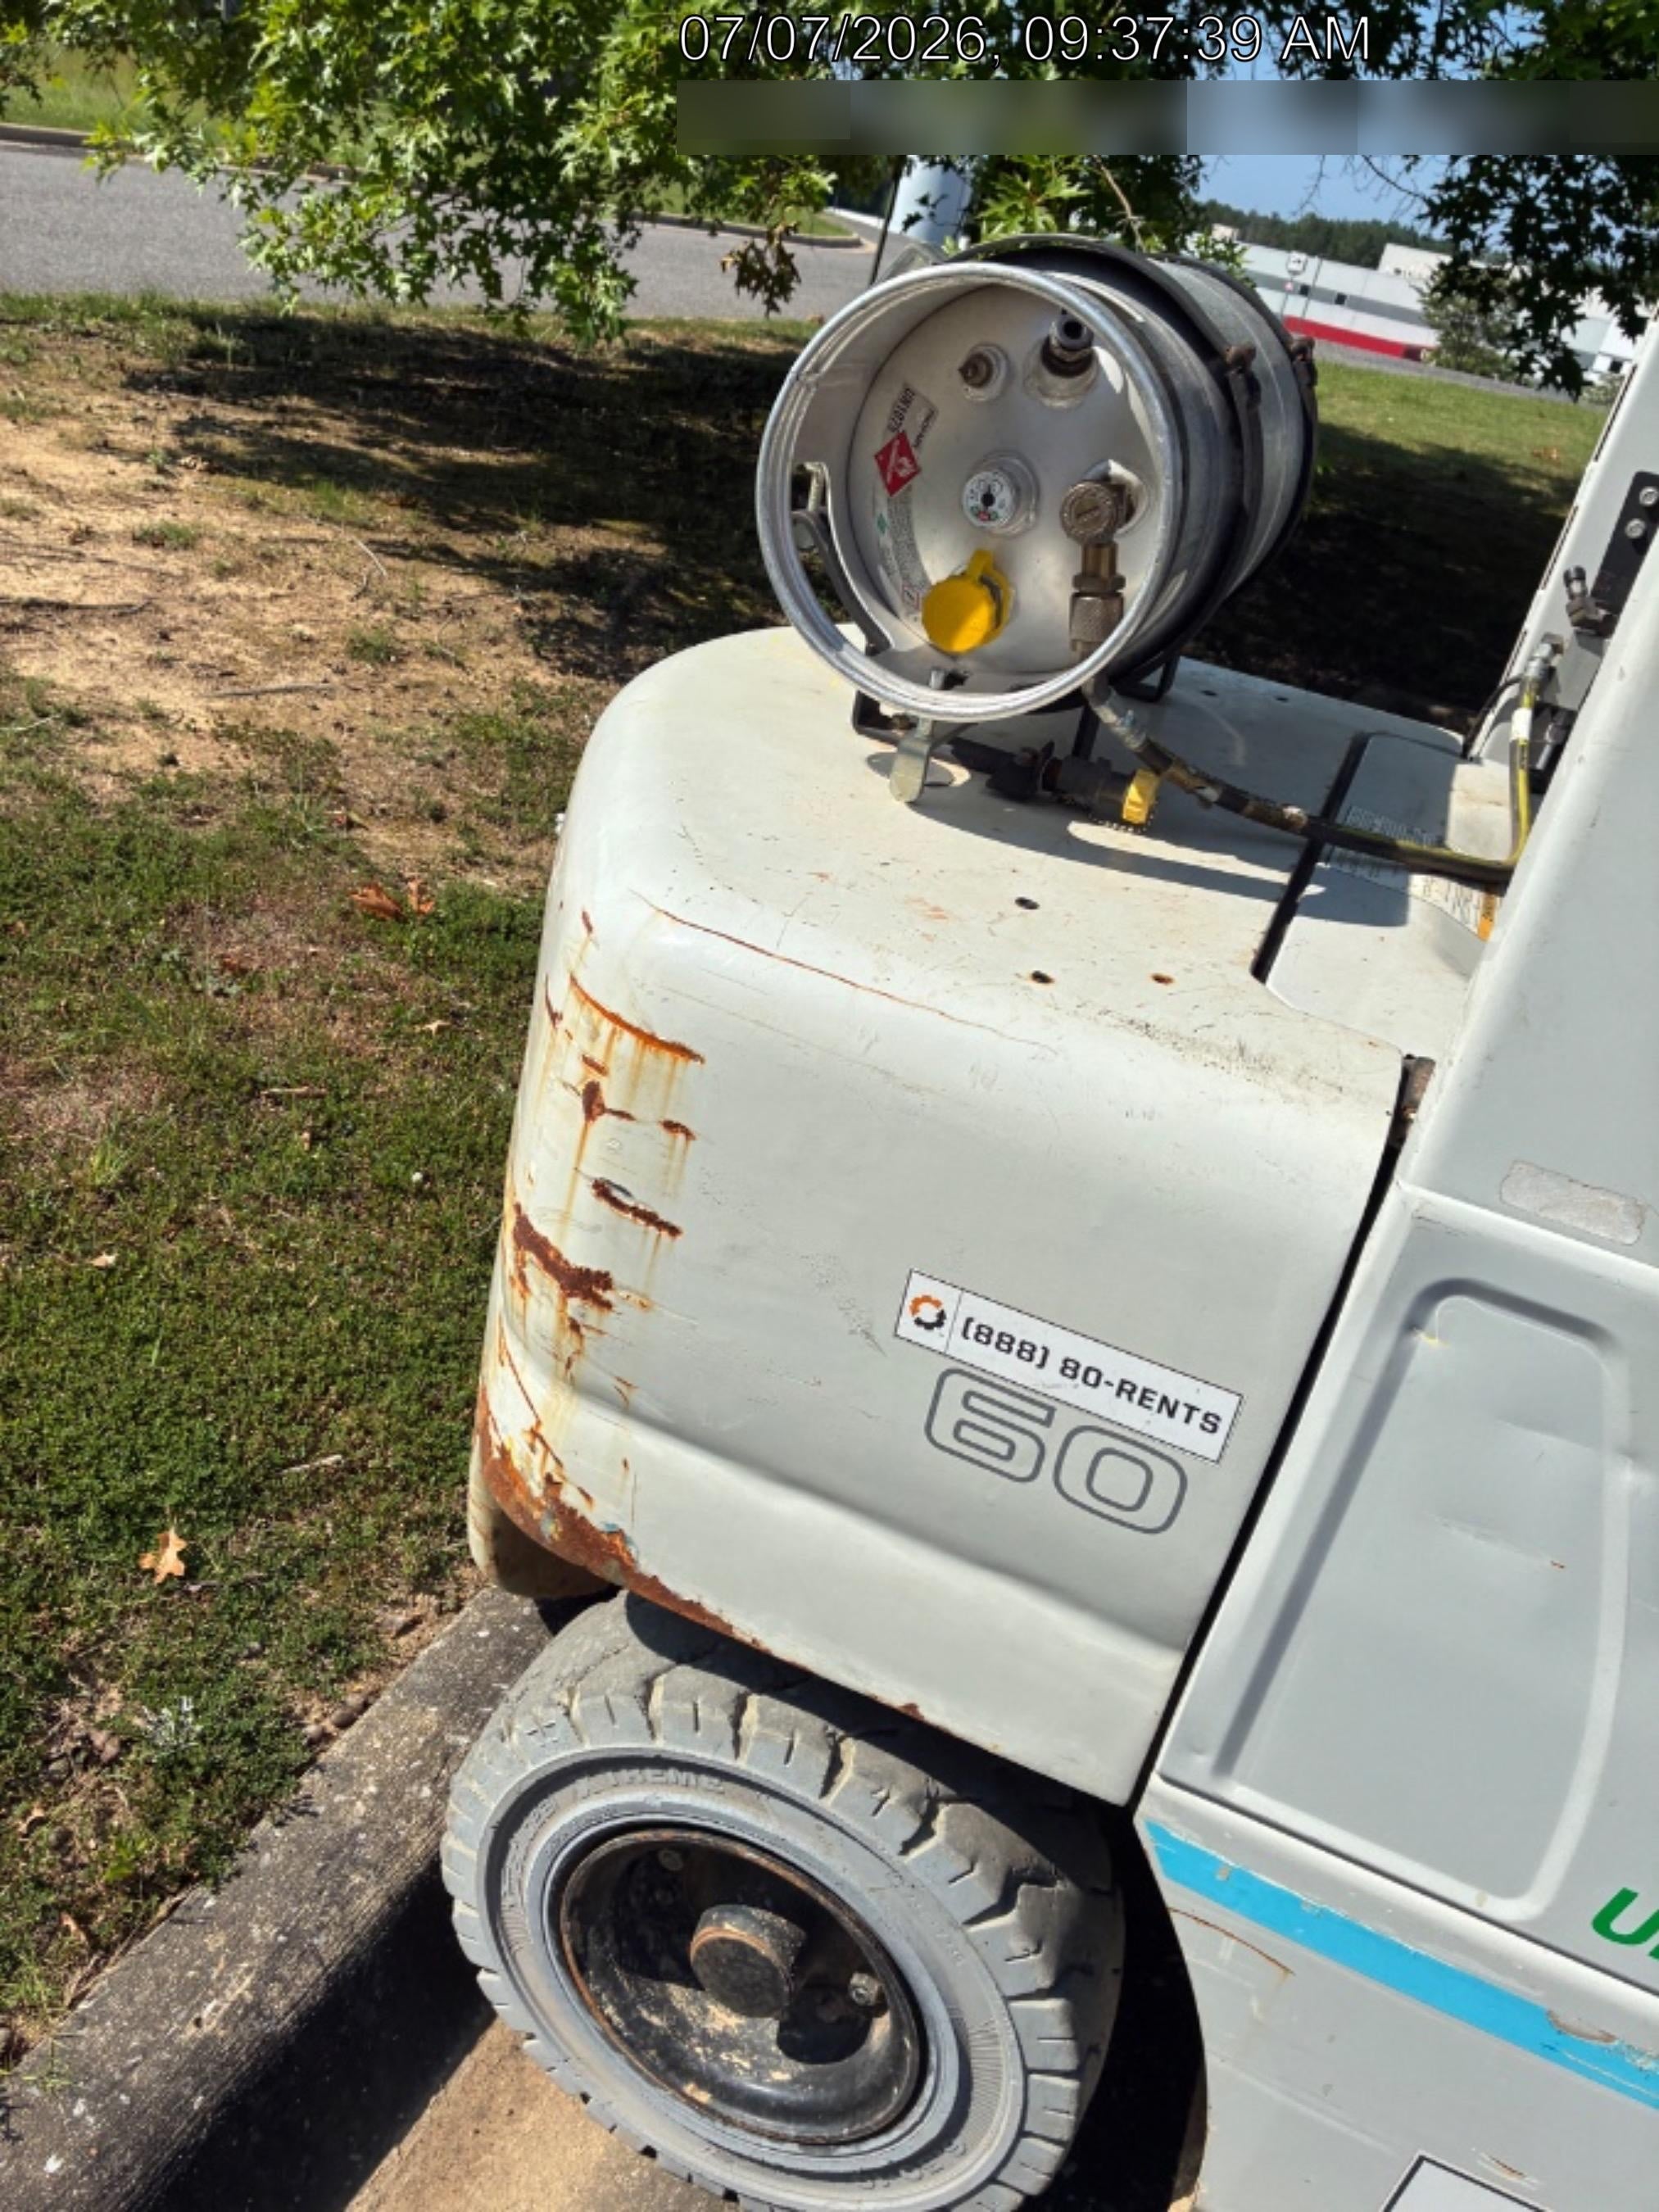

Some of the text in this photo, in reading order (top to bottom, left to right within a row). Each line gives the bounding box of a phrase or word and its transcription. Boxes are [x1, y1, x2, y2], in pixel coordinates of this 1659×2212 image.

[960, 1316, 1223, 1435] (888) 80-RENTS
[923, 1367, 1188, 1534] 60
